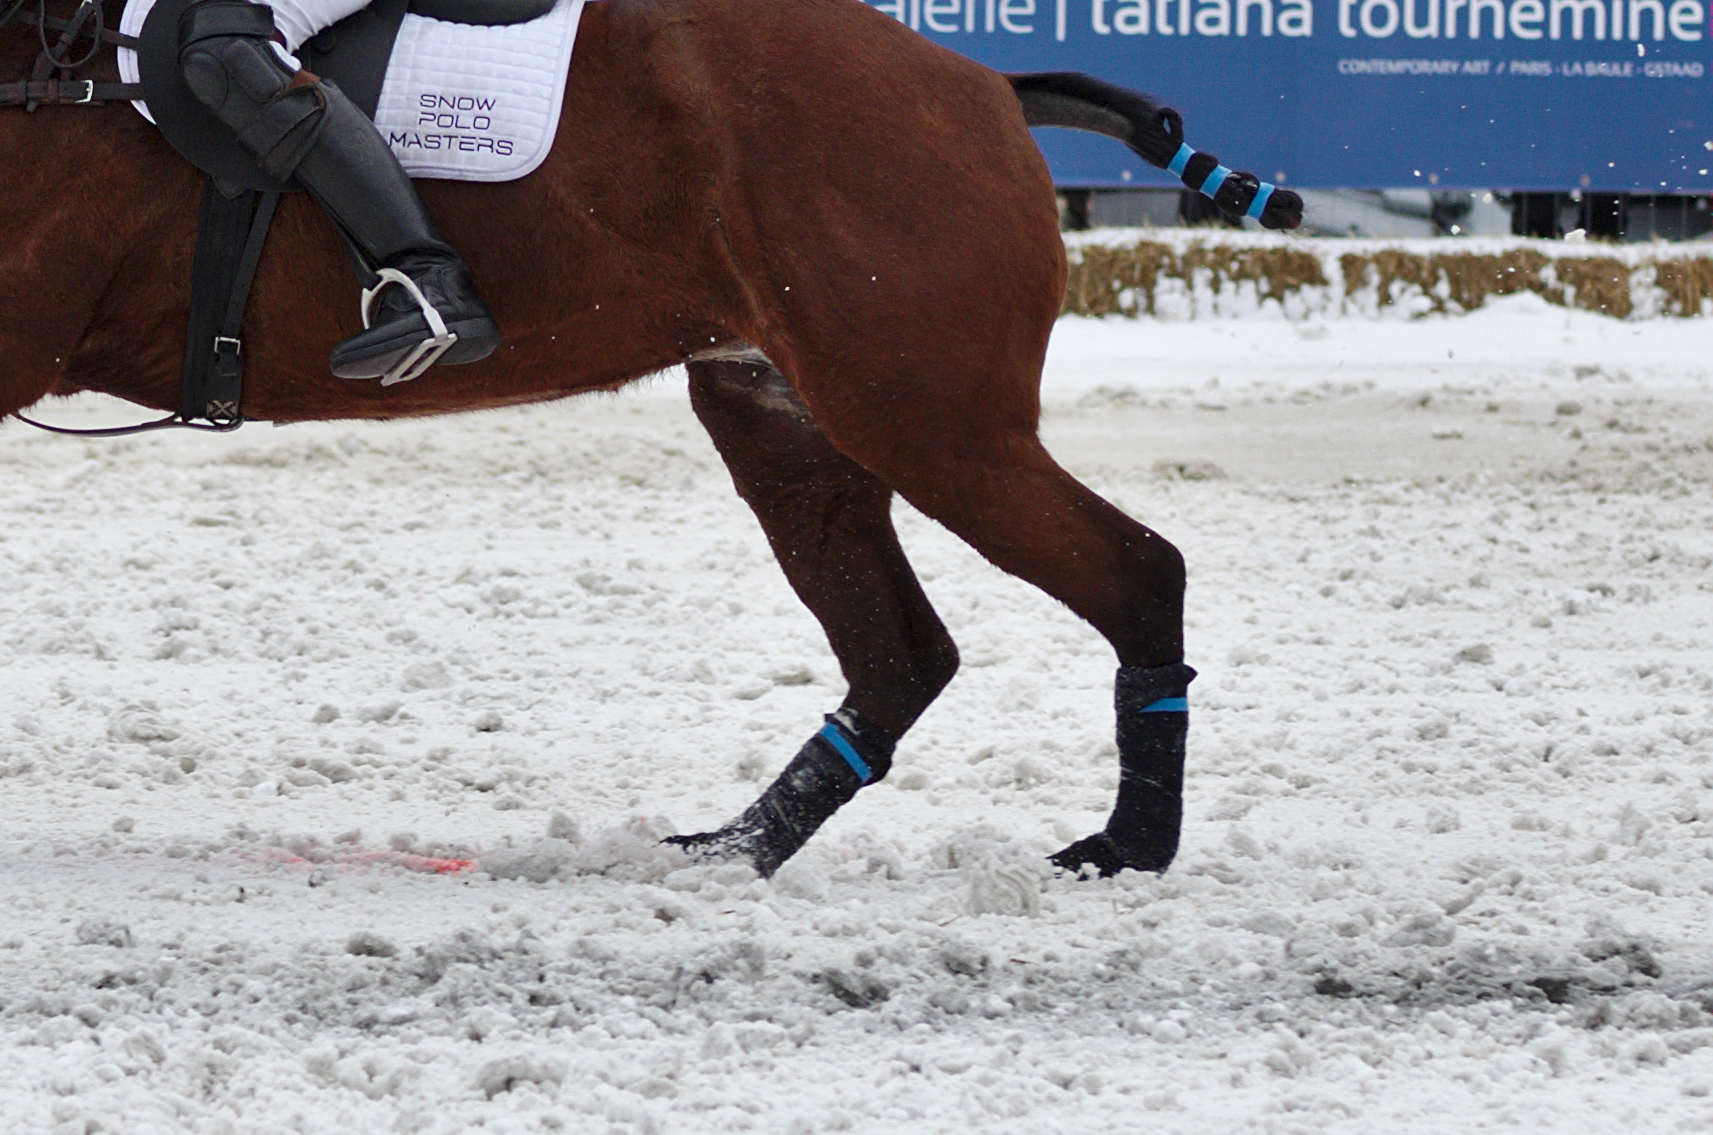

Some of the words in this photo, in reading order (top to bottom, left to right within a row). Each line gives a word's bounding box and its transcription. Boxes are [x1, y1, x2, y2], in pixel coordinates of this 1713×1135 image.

[419, 93, 496, 111] SNOW
[418, 111, 491, 130] POLO
[389, 131, 514, 156] MASTERS
